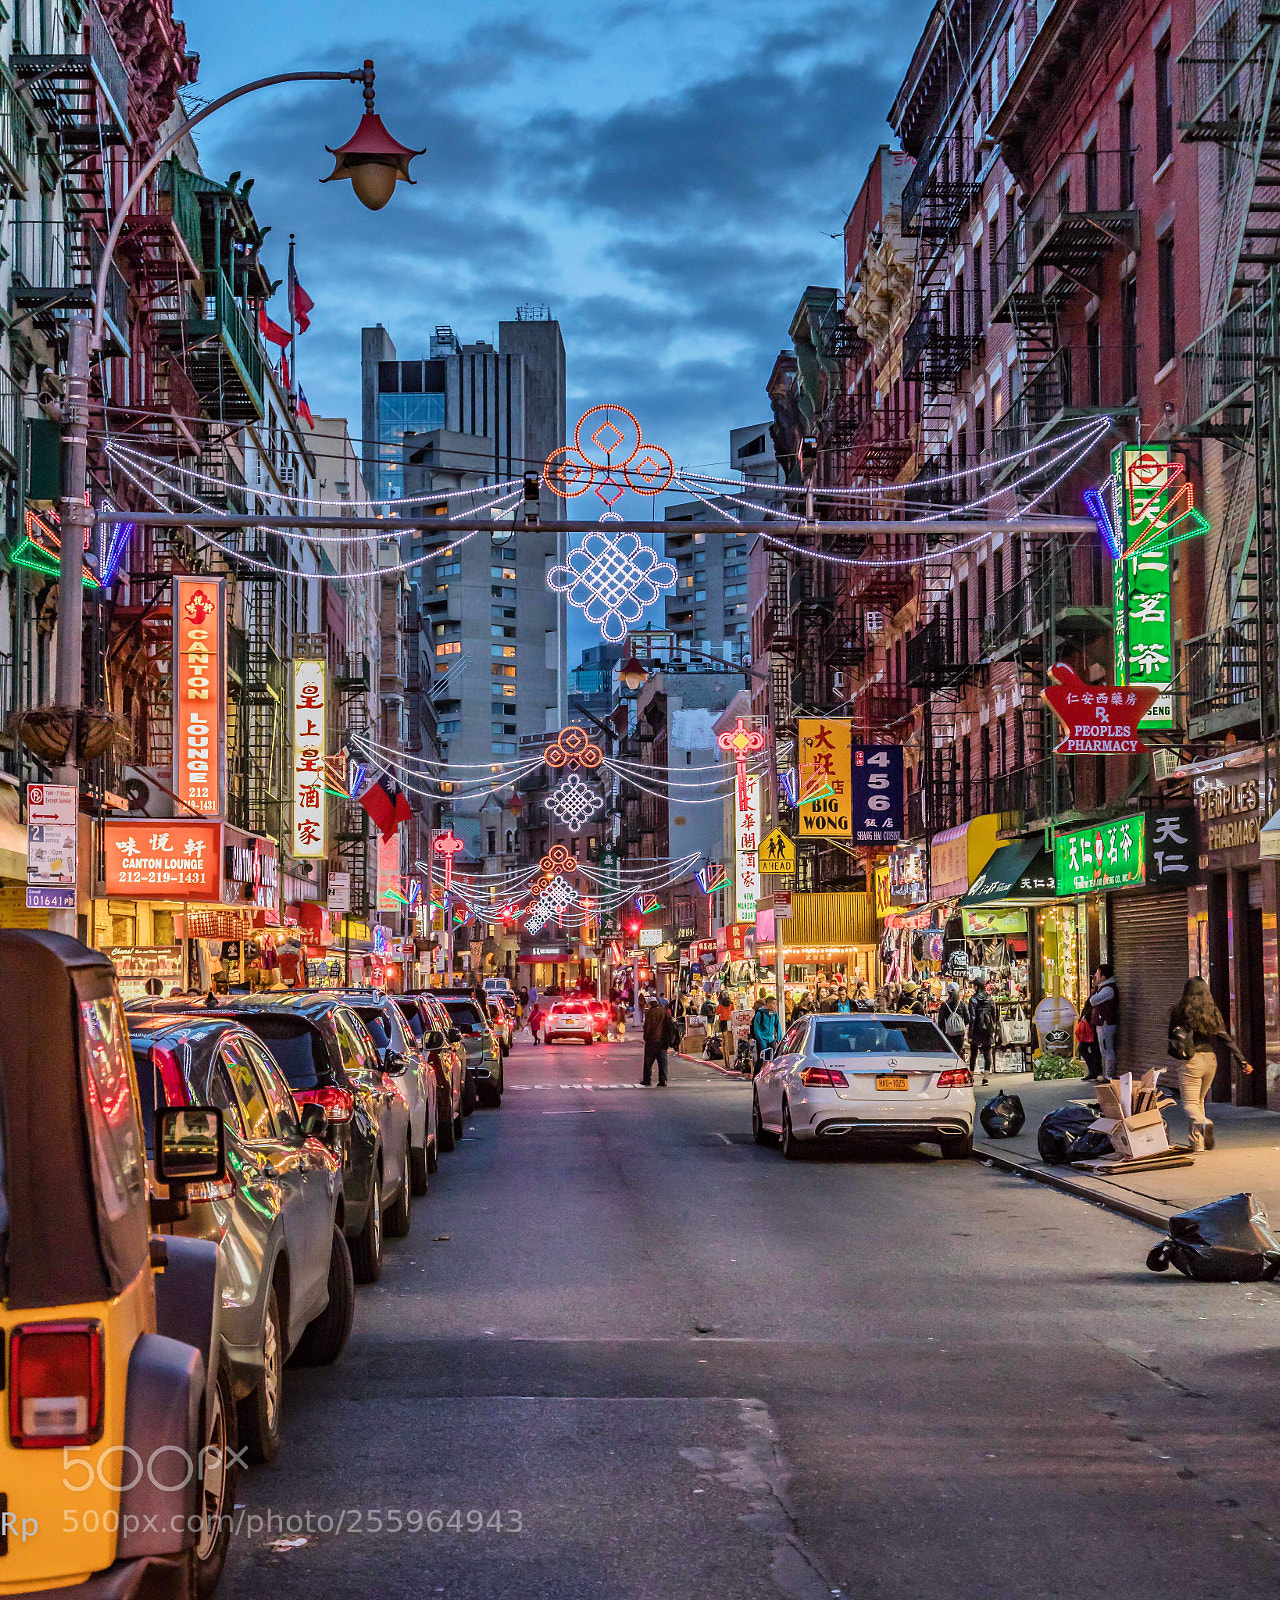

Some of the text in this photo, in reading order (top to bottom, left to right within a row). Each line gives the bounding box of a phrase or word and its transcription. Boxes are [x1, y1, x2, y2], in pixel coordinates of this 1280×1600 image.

[187, 629, 210, 699] CANTON
[1067, 692, 1137, 706] 仁安西藥房
[1075, 725, 1131, 737] PEOPLES
[187, 713, 210, 783] LOUNGE
[1067, 740, 1138, 752] PHARMACY
[296, 682, 323, 845] 皇上皇酒家
[189, 787, 208, 797] 212
[812, 799, 838, 812] BIG
[1200, 779, 1257, 821] PEOPLES
[804, 816, 848, 830] WONG
[864, 818, 894, 828] 飯店
[32, 826, 40, 841] 2
[1208, 817, 1261, 850] PHARMACY
[1069, 823, 1133, 872] 天仁茗茶
[1153, 816, 1189, 875] 天仁
[122, 858, 204, 870] CANTON LOUNGE
[763, 862, 791, 870] AHEAD
[119, 872, 207, 883] 212-219-1431
[28, 896, 62, 906] 101641
